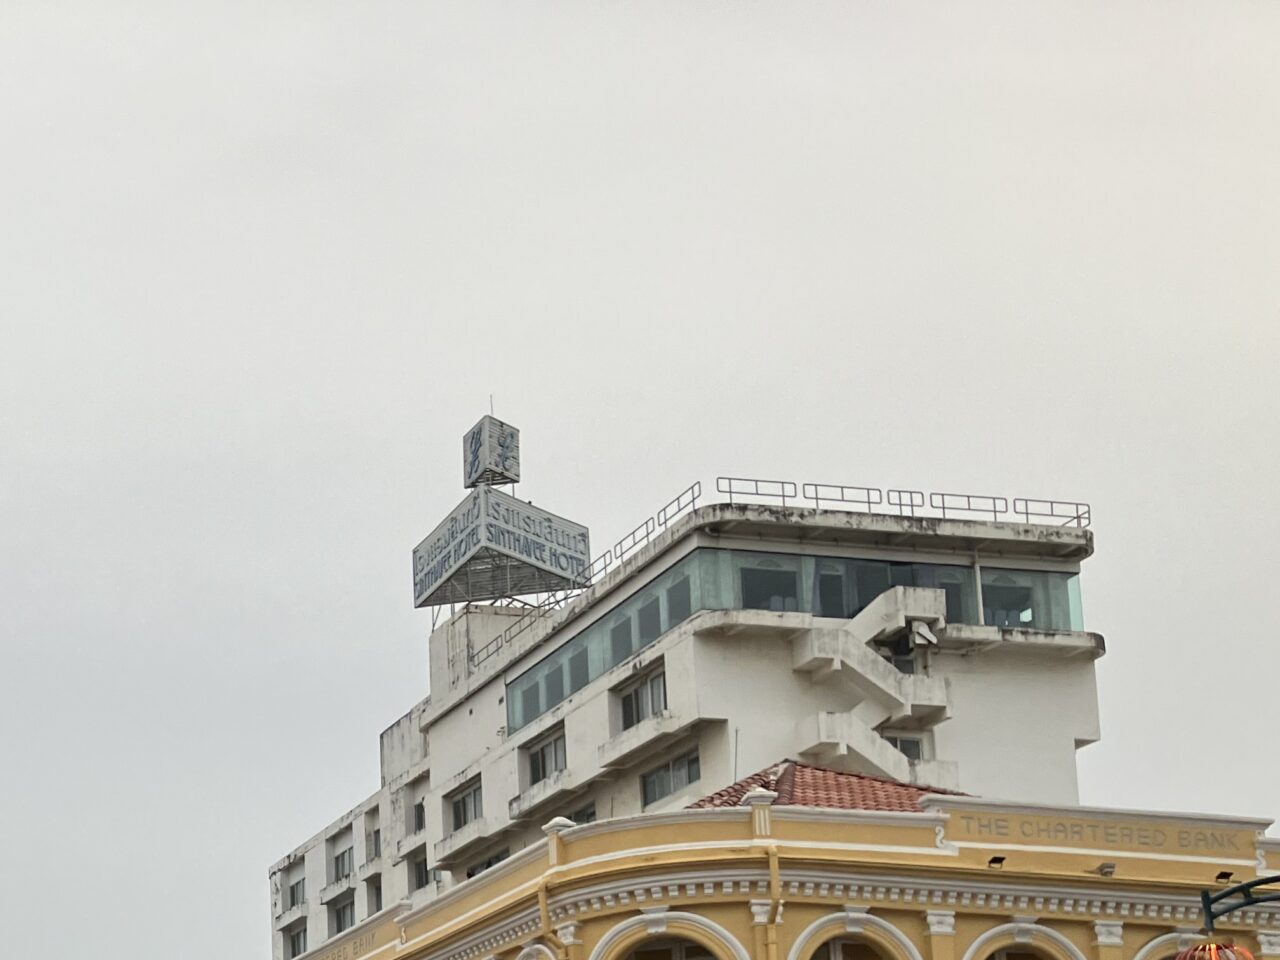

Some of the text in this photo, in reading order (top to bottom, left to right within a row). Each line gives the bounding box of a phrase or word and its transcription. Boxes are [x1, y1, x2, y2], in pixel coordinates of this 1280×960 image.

[960, 816, 1241, 851] THE CHARTERED BANK
